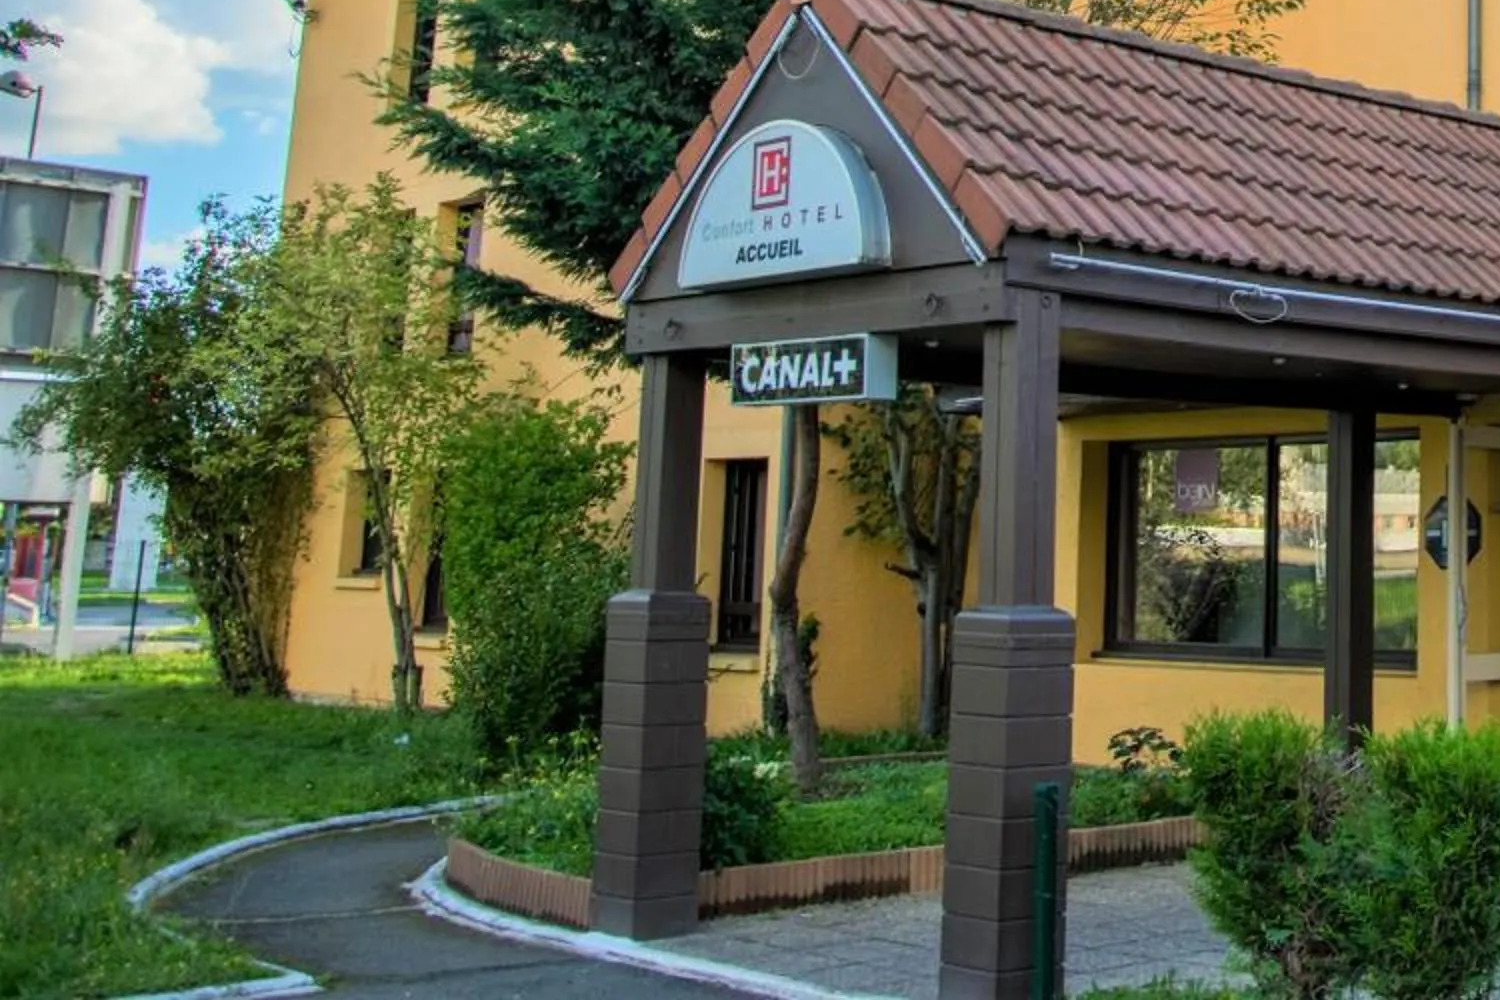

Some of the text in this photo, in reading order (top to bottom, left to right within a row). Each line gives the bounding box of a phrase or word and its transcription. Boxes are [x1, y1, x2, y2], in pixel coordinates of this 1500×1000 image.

[762, 203, 843, 232] HOTEL
[735, 237, 804, 264] ACCUEIL
[740, 347, 858, 394] CANAL+
